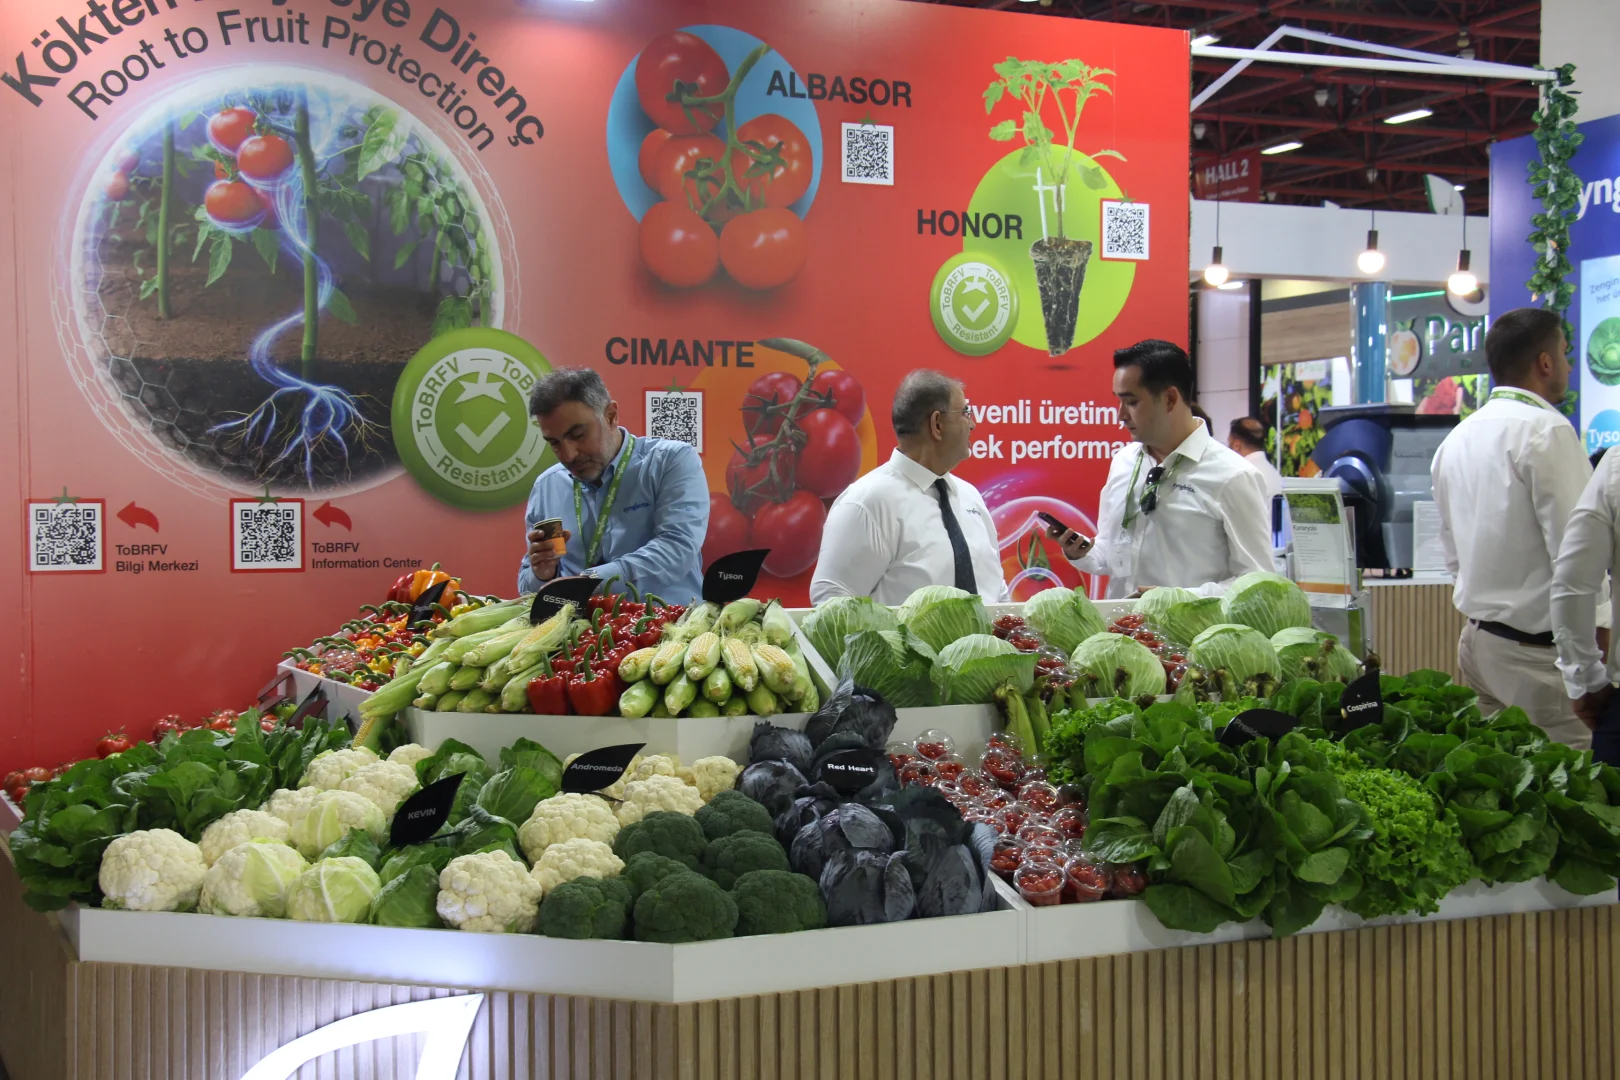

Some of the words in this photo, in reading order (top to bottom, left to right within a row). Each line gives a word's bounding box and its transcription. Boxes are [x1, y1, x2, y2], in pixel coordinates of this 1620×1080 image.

[67, 39, 166, 121] Root
[164, 26, 209, 59] to
[216, 9, 310, 46] Fruit
[322, 15, 495, 152] Protection
[419, 7, 545, 148] Direnç
[766, 69, 912, 108] ALBASOR
[1205, 160, 1239, 185] HALL
[1240, 158, 1249, 177] 2
[1577, 175, 1620, 221] yng
[917, 208, 1023, 240] HONOR
[942, 267, 965, 310] ToBRFV
[984, 267, 1009, 311] ToBRFV
[952, 323, 999, 342] Resistant
[605, 336, 755, 368] CIMANTE
[416, 356, 460, 433] ToBRFV
[1039, 399, 1125, 430] üretim,
[1011, 435, 1131, 465] performa
[437, 454, 528, 487] Resistant
[116, 545, 168, 556] ToBRFV
[312, 543, 360, 553] ToBRFV
[116, 561, 145, 574] Bilgi
[149, 561, 199, 571] Merkezi
[312, 559, 380, 569] Information
[383, 558, 423, 568] Center
[718, 571, 744, 581] Tyson
[1346, 701, 1379, 713] Cospirina
[570, 763, 624, 773] Andromeda
[827, 763, 846, 771] Red
[847, 764, 875, 773] Heart
[407, 808, 437, 820] KEVIN
